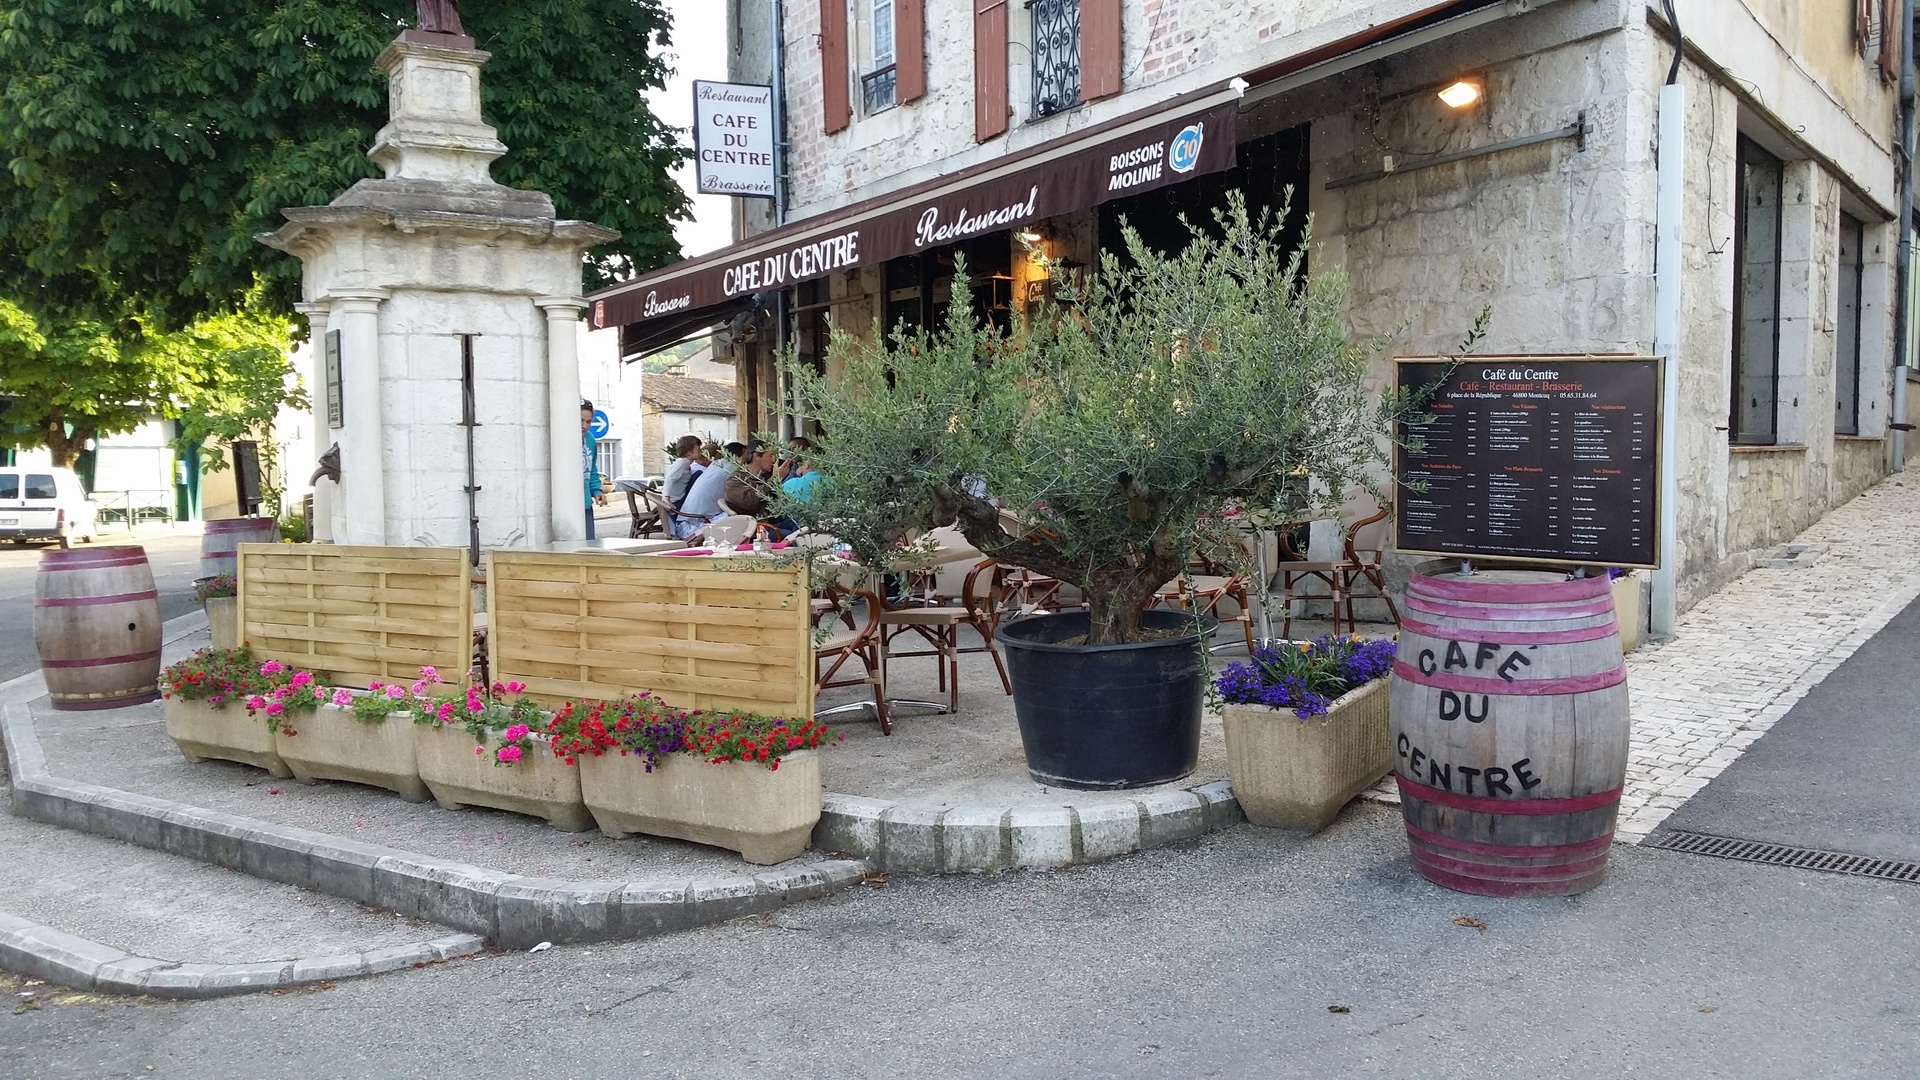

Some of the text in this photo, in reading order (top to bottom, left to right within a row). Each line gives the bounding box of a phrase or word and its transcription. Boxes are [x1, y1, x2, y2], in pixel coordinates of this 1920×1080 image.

[699, 86, 769, 104] Restaurant
[713, 114, 758, 129] CAFE
[723, 133, 748, 148] DU
[1174, 138, 1198, 163] C10
[701, 149, 772, 166] CENTRE
[1109, 141, 1164, 171] BOISSONS
[703, 174, 772, 192] Brasserie
[1108, 159, 1163, 191] MOLINIÉ
[915, 185, 1038, 247] Restaurant
[723, 231, 860, 296] CAFE DU CENTRE
[643, 290, 690, 317] Brasserie
[1460, 381, 1480, 391] Café
[1489, 382, 1533, 391] Restaurant
[1542, 381, 1583, 391] Brasserie
[1482, 369, 1559, 380] Café du Centre
[1418, 640, 1538, 682] CAFÉ
[1439, 690, 1489, 723] DU
[1397, 733, 1541, 797] CENTRE
